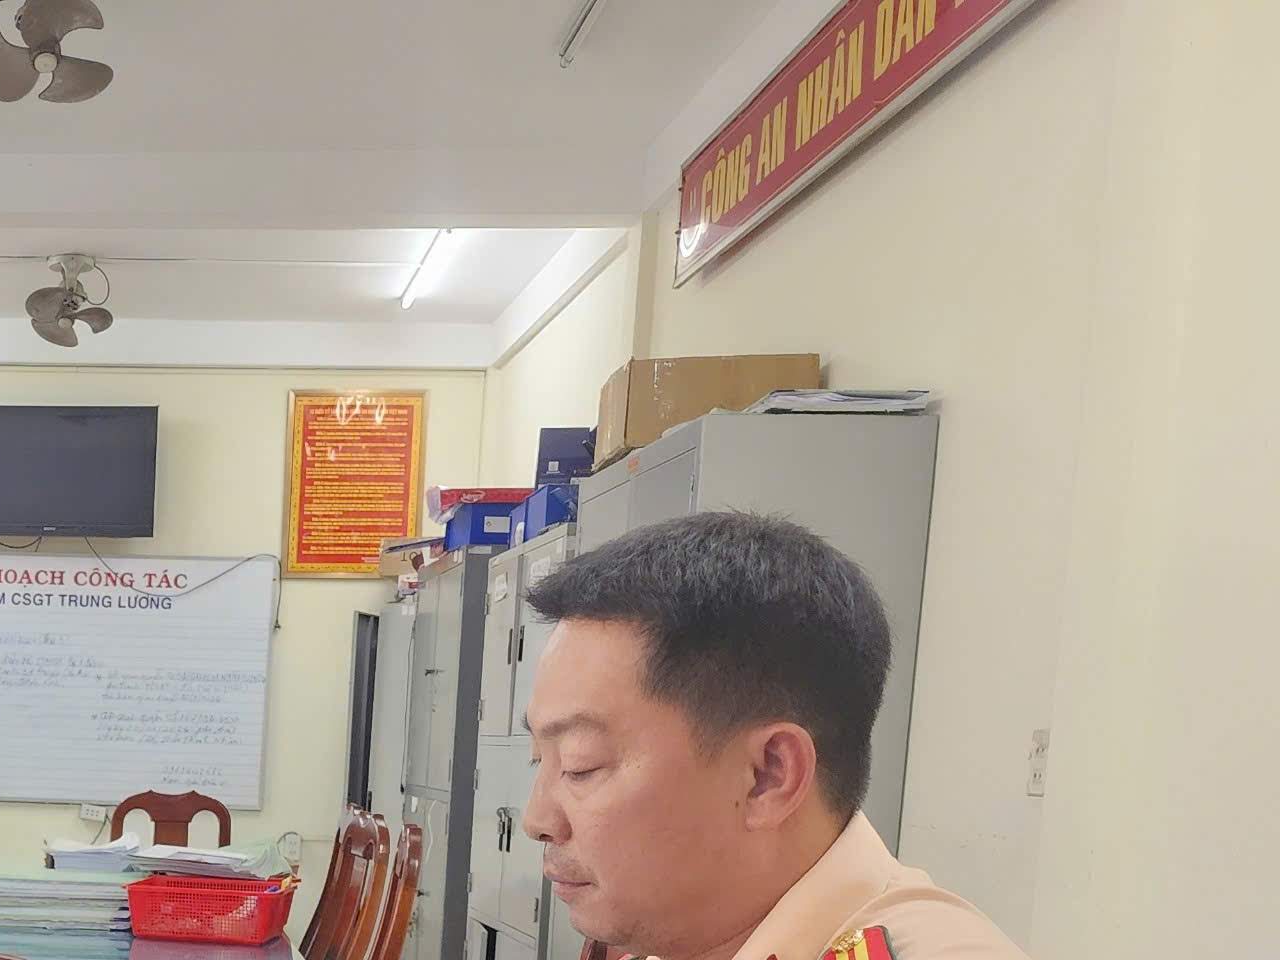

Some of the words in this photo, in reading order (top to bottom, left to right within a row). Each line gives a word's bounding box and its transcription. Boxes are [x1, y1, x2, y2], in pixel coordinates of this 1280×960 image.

[755, 96, 788, 185] AN
[794, 20, 866, 150] NHÂN
[73, 568, 135, 588] CÔNG
[143, 569, 188, 589] TÁC
[11, 593, 53, 606] CSGT
[59, 594, 112, 608] TRUNG
